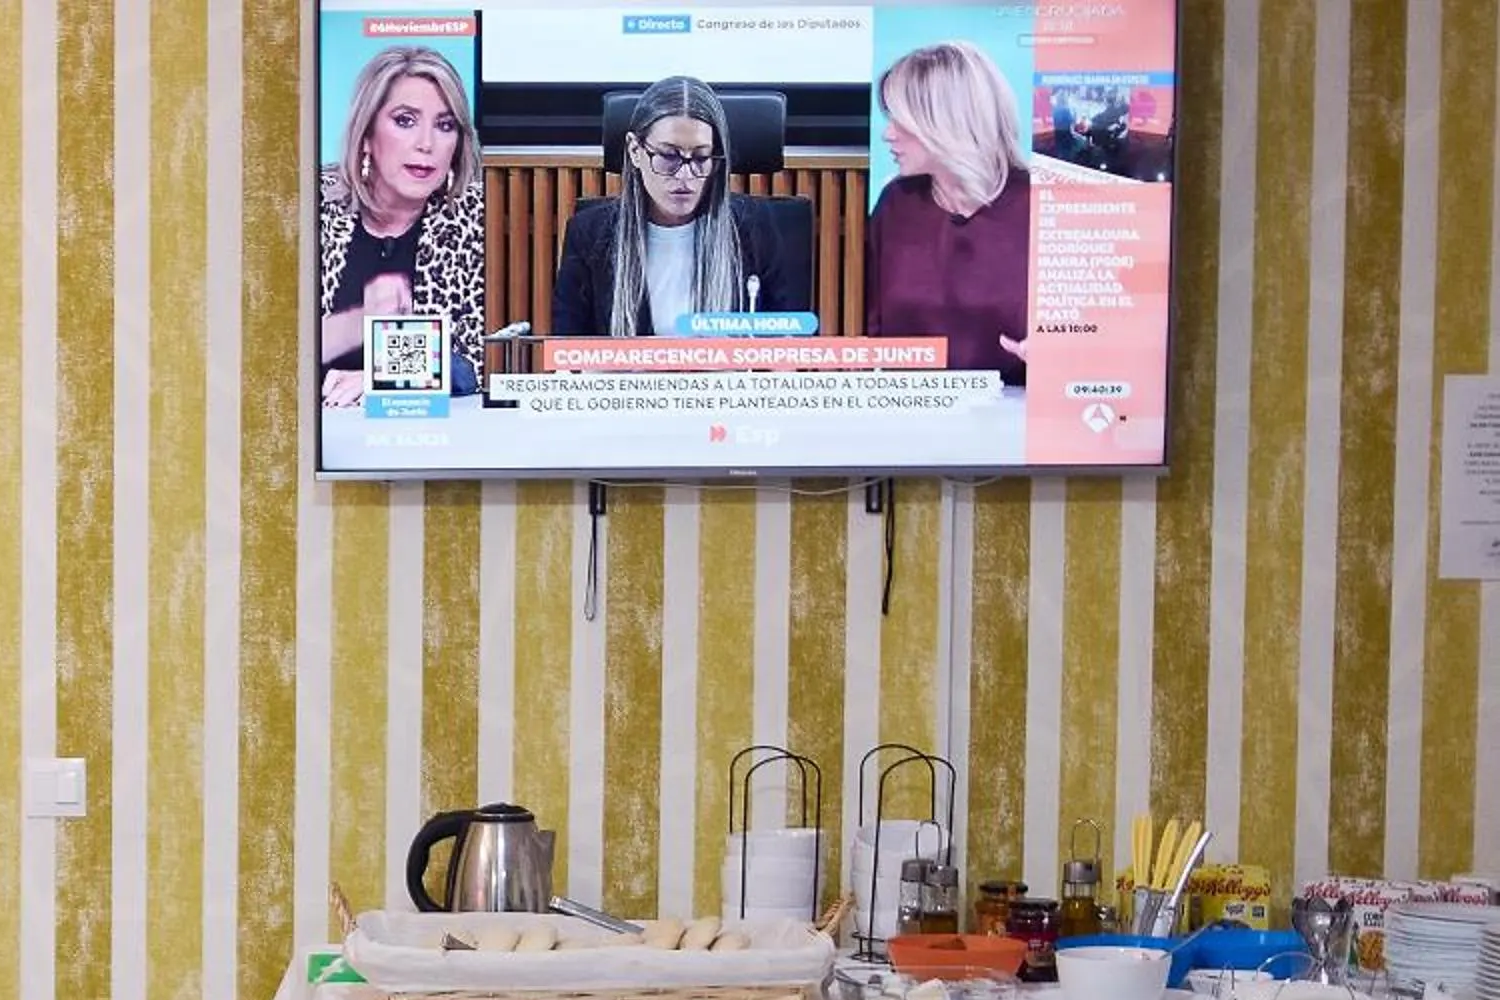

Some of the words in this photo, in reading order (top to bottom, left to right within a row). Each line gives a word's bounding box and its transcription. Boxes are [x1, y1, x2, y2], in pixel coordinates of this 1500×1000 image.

[697, 18, 756, 32] Congreso
[758, 17, 775, 30] de
[798, 17, 861, 31] Diputados
[1038, 229, 1140, 241] EXTREMADURA
[1036, 282, 1124, 295] ACTUALIDAD
[691, 315, 752, 331] ÚLTIMA
[756, 316, 802, 331] HORA
[1036, 325, 1045, 333] A
[1047, 324, 1067, 333] LAS
[1069, 324, 1098, 333] 10:00
[554, 348, 728, 365] COMPARECENCIA
[732, 347, 836, 364] SORPRESA
[842, 347, 869, 363] DE
[872, 346, 936, 363] JUNTS
[619, 378, 709, 391] ENMIENDAS
[713, 378, 726, 390] A
[728, 378, 746, 390] LA
[750, 377, 837, 390] TOTALIDAD
[842, 377, 855, 389] A
[857, 376, 908, 389] TODAS
[911, 376, 939, 389] LAS
[943, 376, 989, 389] LEYES
[531, 397, 563, 412] QUE
[567, 397, 584, 410] EL
[587, 397, 669, 411] GOBIERNO
[674, 397, 714, 409] TIENE
[719, 396, 819, 409] PLANTEADAS
[823, 396, 843, 408] EN
[847, 396, 863, 408] EL
